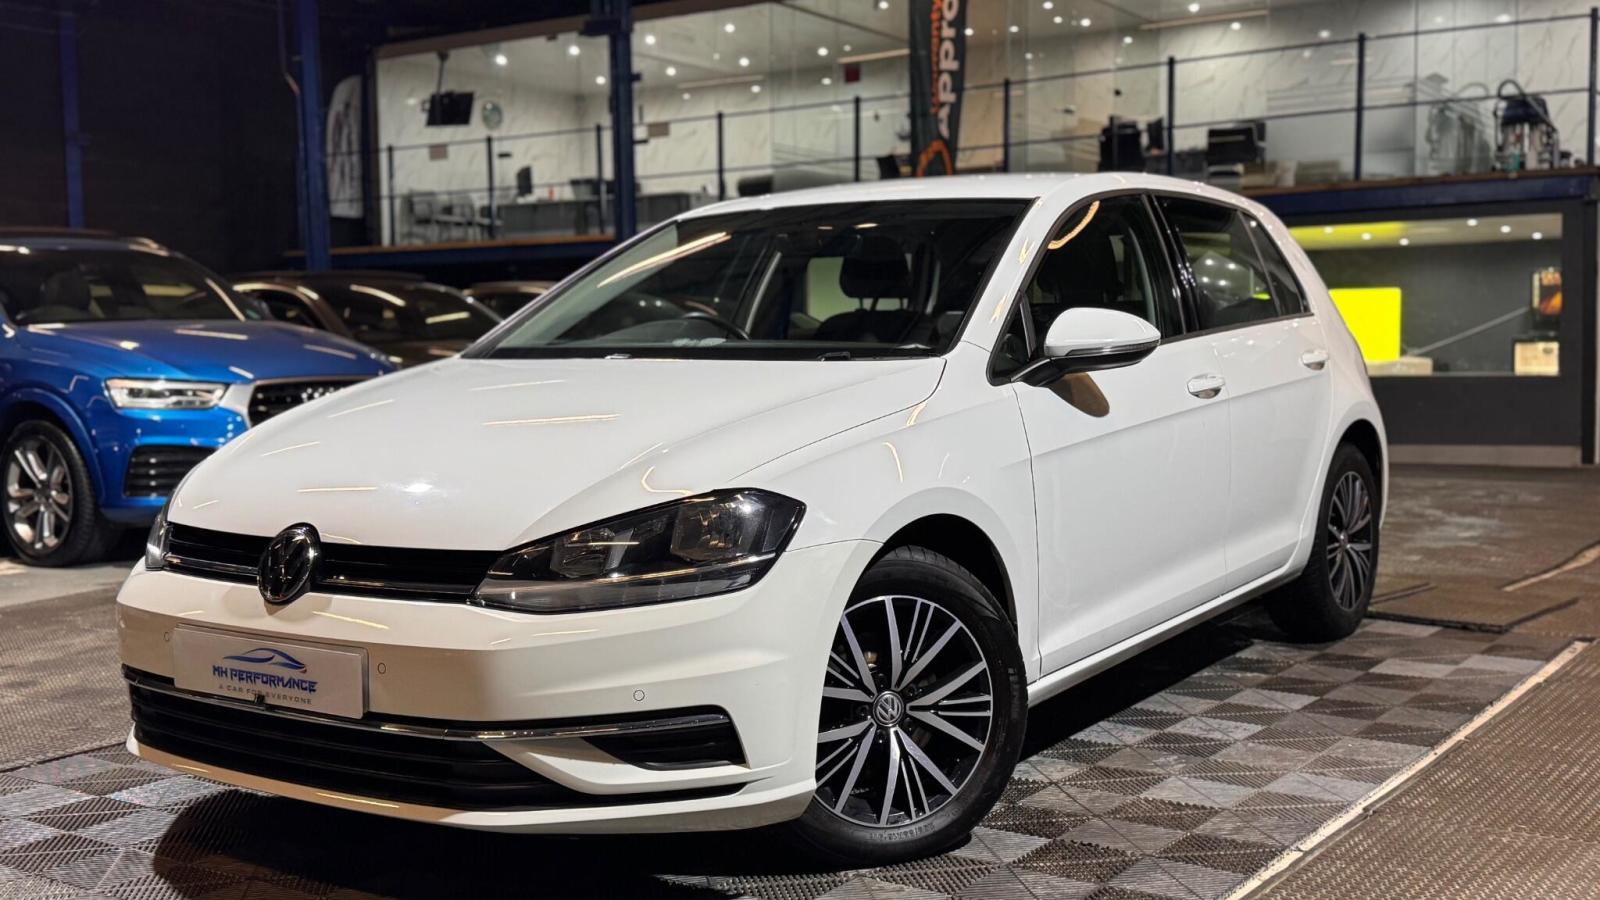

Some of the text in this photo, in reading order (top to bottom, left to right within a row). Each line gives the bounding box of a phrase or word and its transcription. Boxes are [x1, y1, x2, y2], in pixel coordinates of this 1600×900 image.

[212, 665, 318, 693] MH PERFORMANCE
[265, 691, 312, 704] EVERYONE
